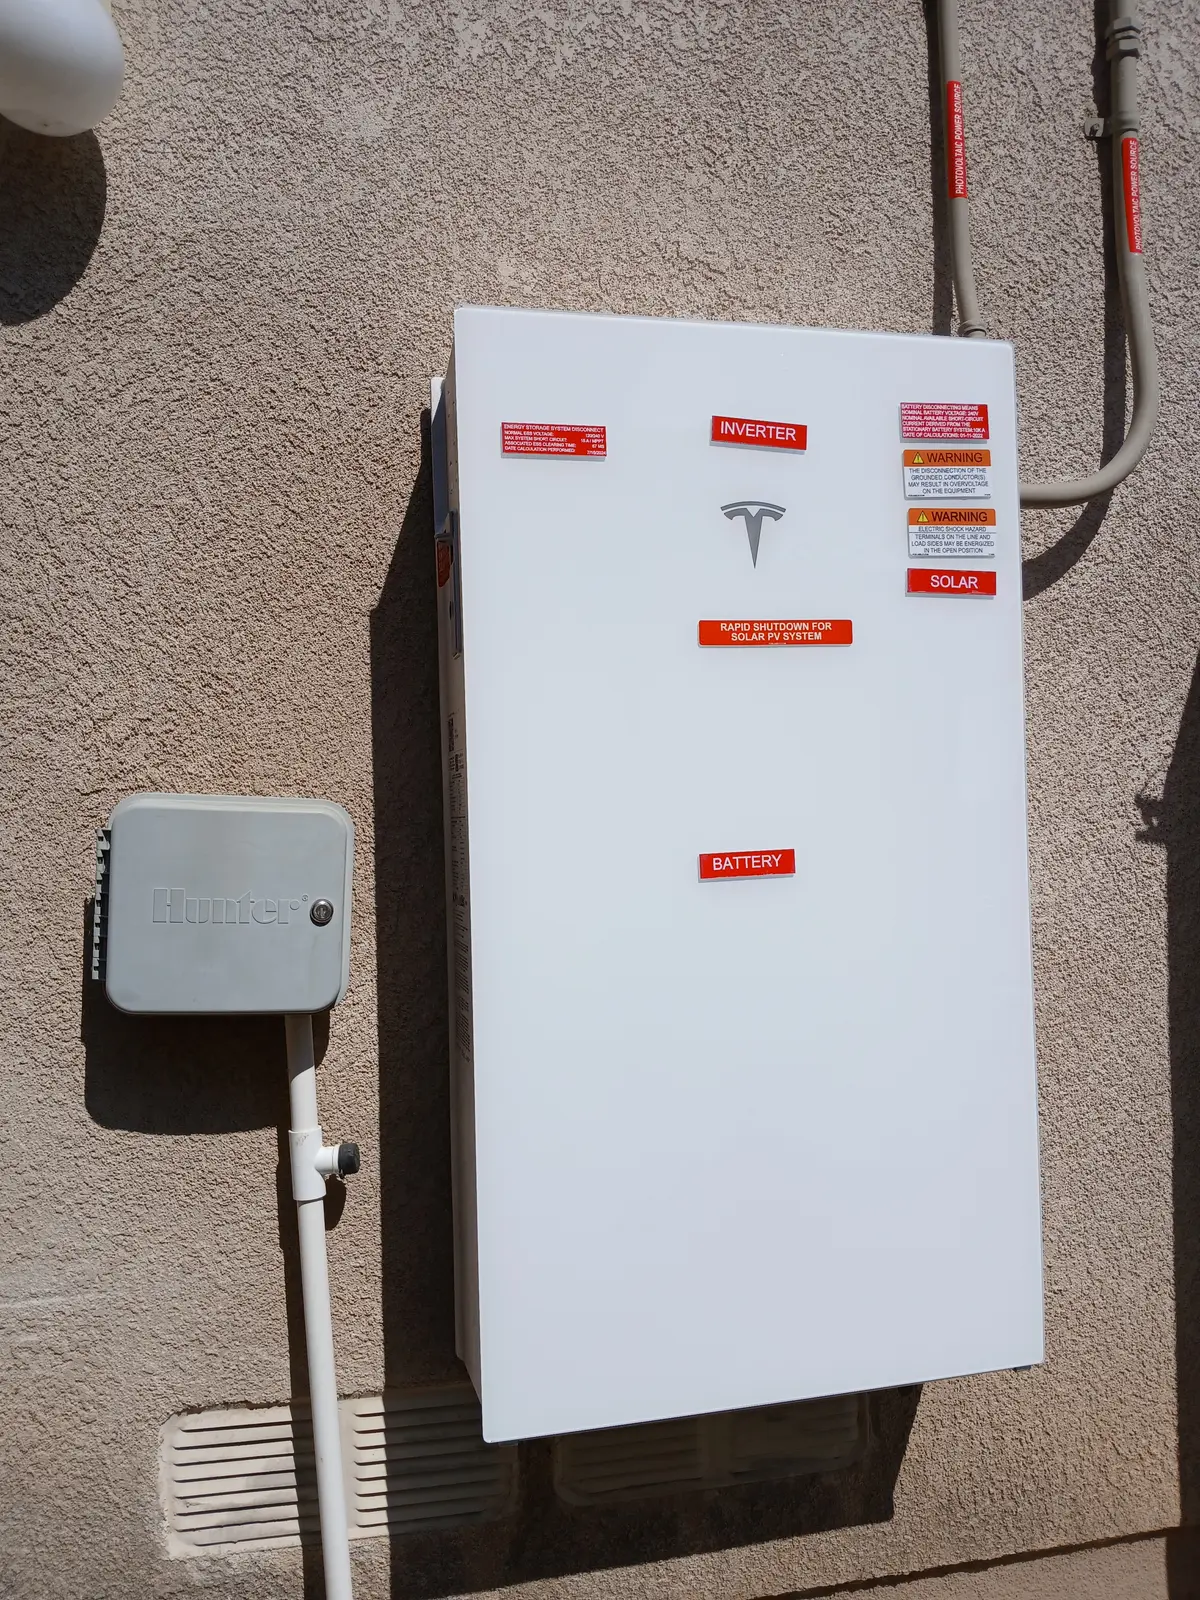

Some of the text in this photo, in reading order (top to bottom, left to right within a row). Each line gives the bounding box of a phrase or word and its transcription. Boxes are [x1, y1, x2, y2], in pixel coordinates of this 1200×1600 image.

[954, 115, 962, 140] POWER
[954, 142, 964, 194] PHOTOVOLTAIC
[1132, 198, 1142, 250] PHOTOVOLTAIC
[720, 421, 796, 441] INVERTER
[927, 452, 983, 463] WARNING
[932, 512, 988, 522] WARNING
[930, 575, 978, 588] SOLAR
[720, 622, 832, 632] RAPID SHUTDOWN FOR
[731, 632, 822, 641] SOLAR PV SYSTEM
[713, 854, 782, 871] BATTERY
[152, 888, 300, 924] Hunter
